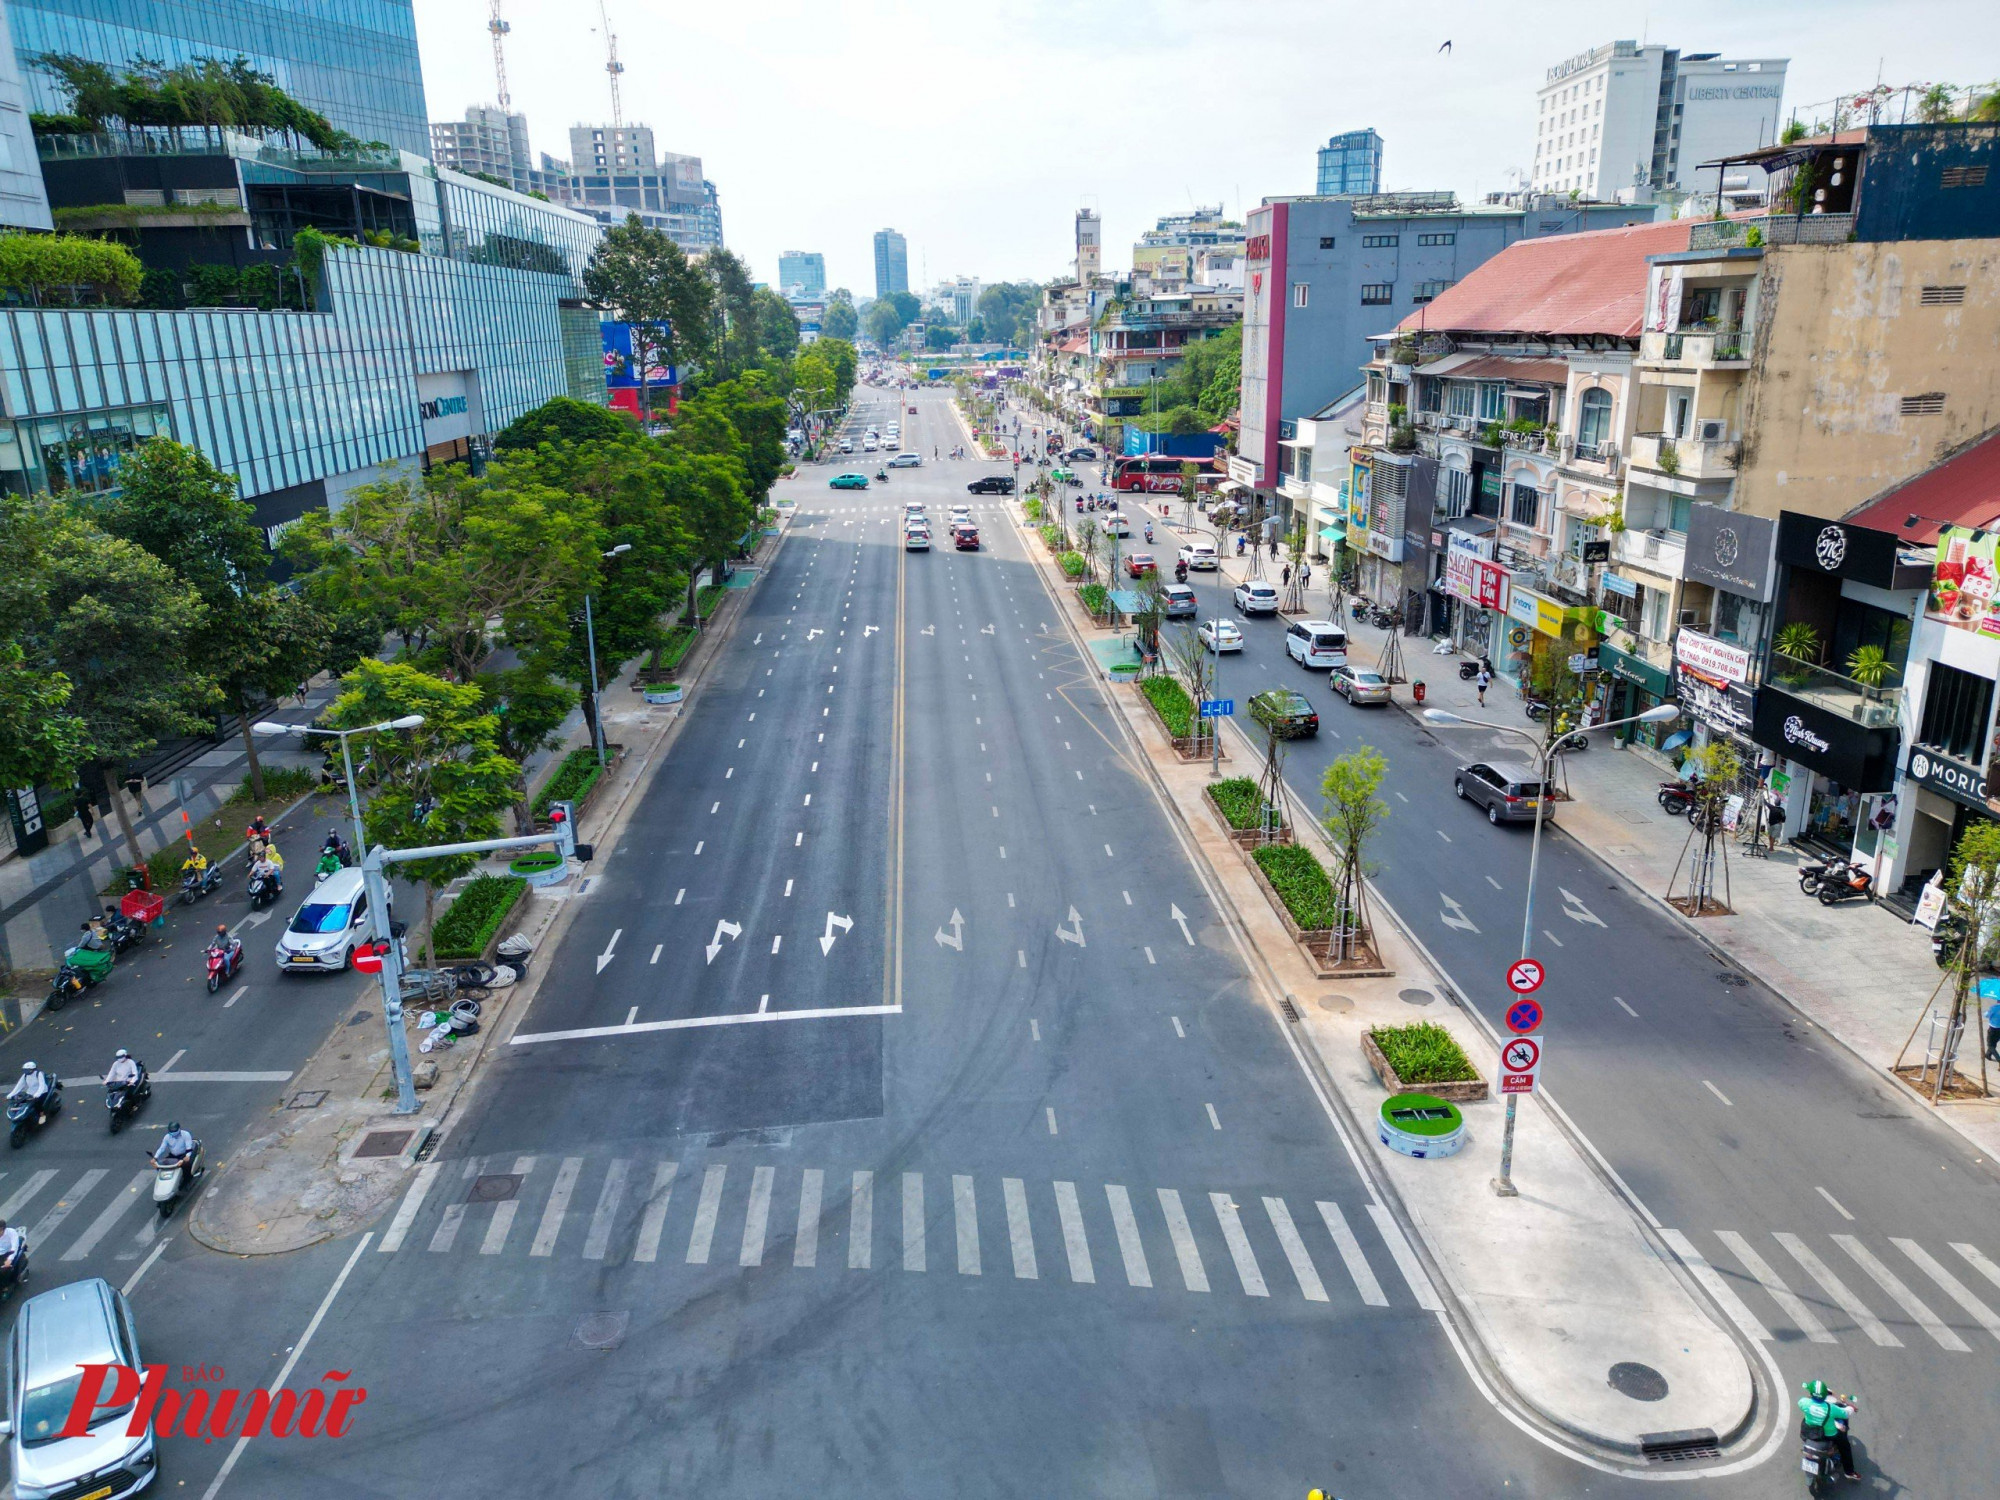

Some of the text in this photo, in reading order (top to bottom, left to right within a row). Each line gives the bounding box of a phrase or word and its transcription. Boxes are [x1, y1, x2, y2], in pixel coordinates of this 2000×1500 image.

[1689, 84, 1780, 100] LIBERTY CENTRAL
[1482, 568, 1497, 586] TÂN
[1481, 583, 1496, 601] TÂN
[1510, 1075, 1527, 1084] CẤM
